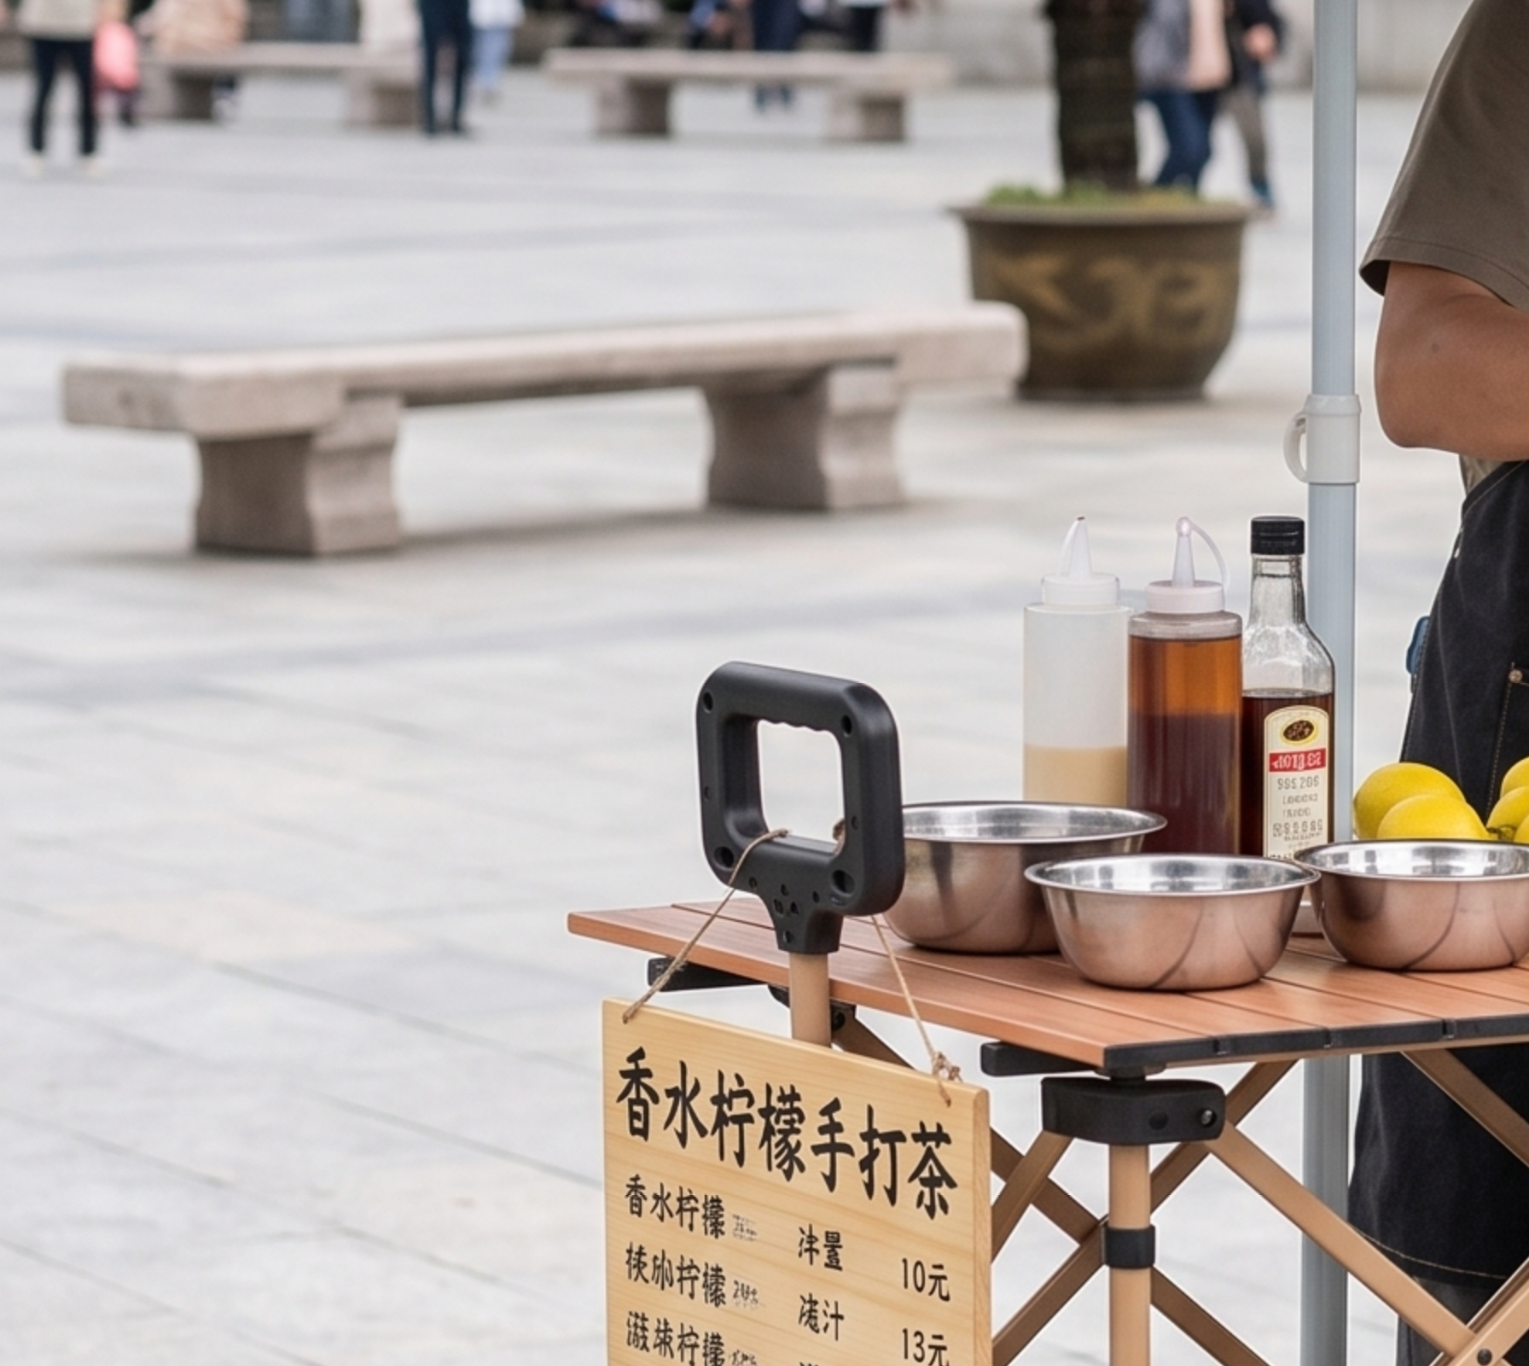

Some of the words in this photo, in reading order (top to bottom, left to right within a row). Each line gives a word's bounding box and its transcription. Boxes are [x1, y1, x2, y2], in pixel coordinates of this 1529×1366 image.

[616, 1046, 958, 1221] 香水柠檬手打茶
[902, 1258, 950, 1302] 10元
